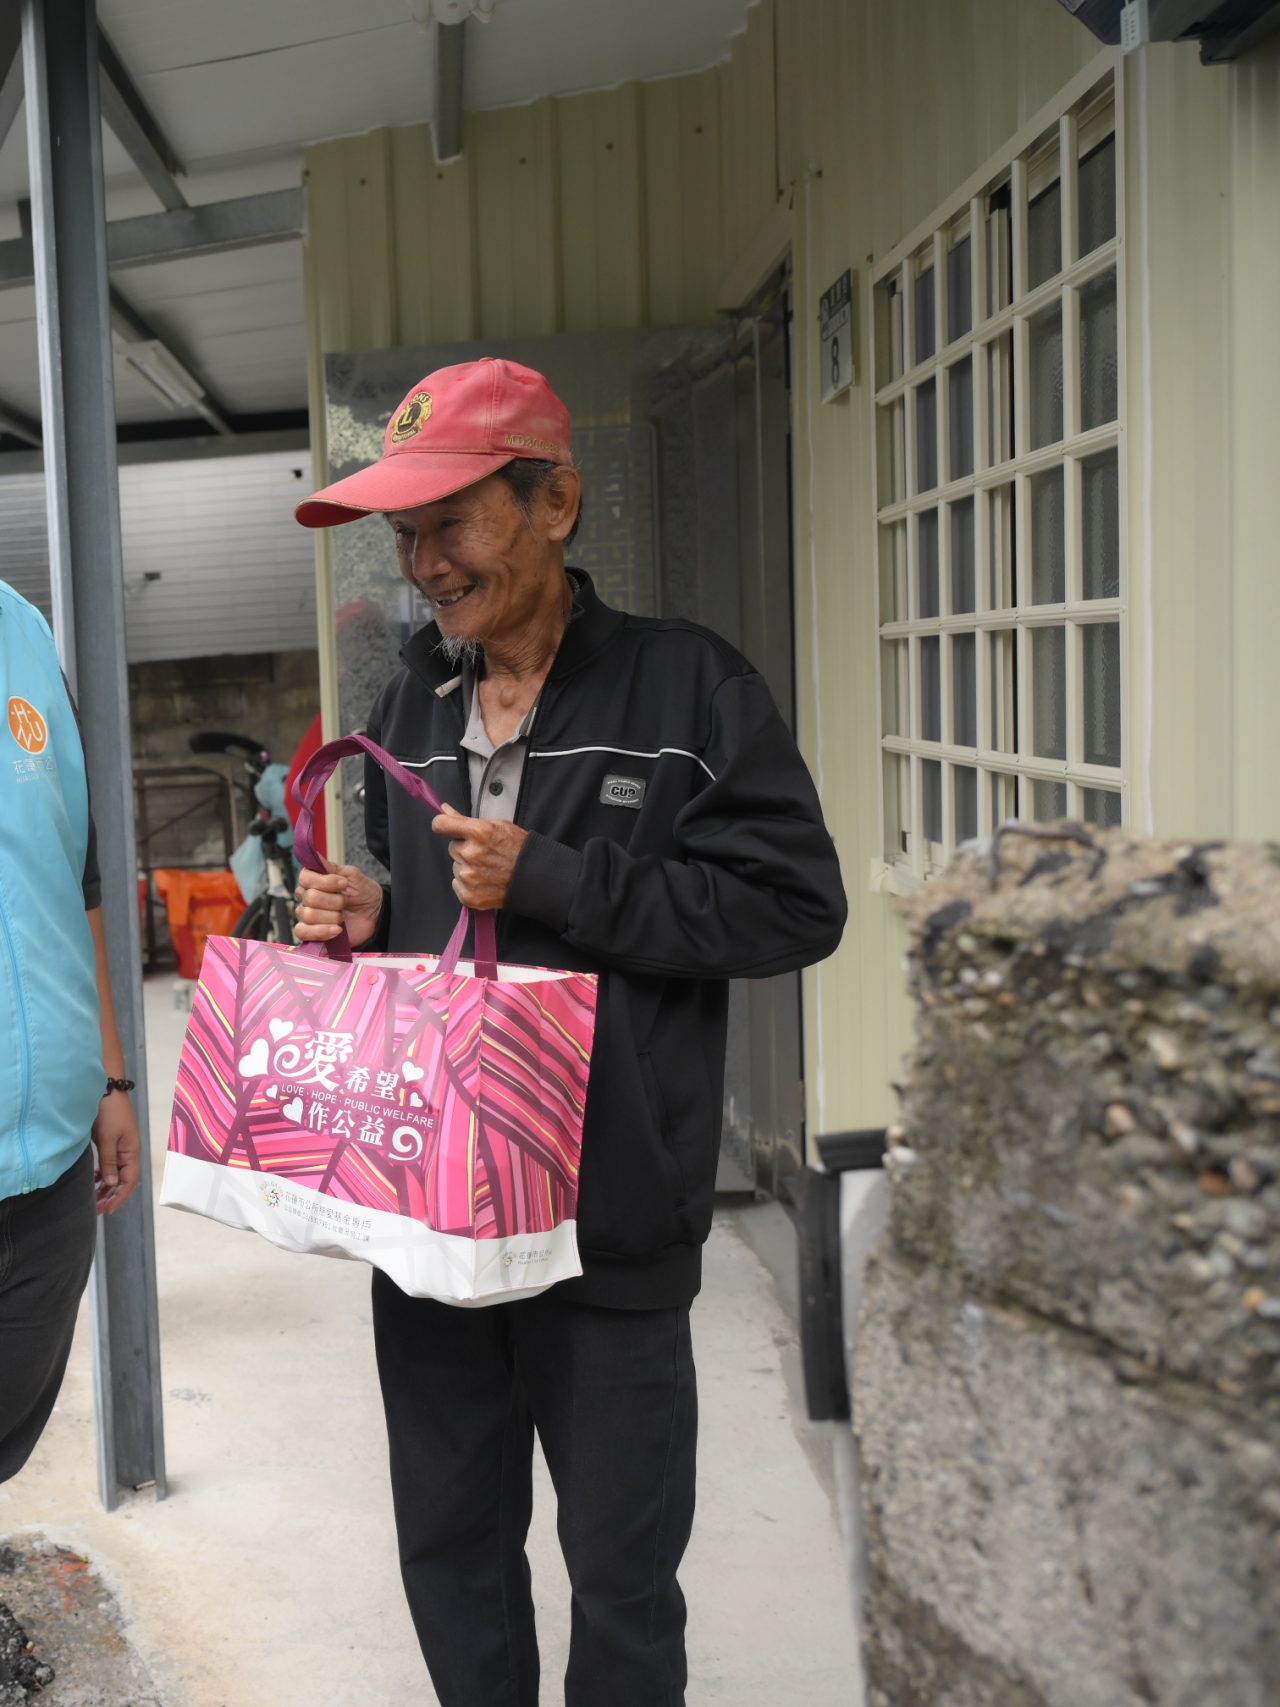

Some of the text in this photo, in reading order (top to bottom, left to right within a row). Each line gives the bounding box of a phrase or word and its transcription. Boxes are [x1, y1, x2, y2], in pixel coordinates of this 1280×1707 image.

[831, 335, 840, 390] 8
[399, 407, 414, 426] L
[12, 755, 57, 775] 花蓮市公
[281, 1083, 434, 1129] LOVE HOPE PUBLIC WELFARE
[308, 1101, 386, 1146] 作公益
